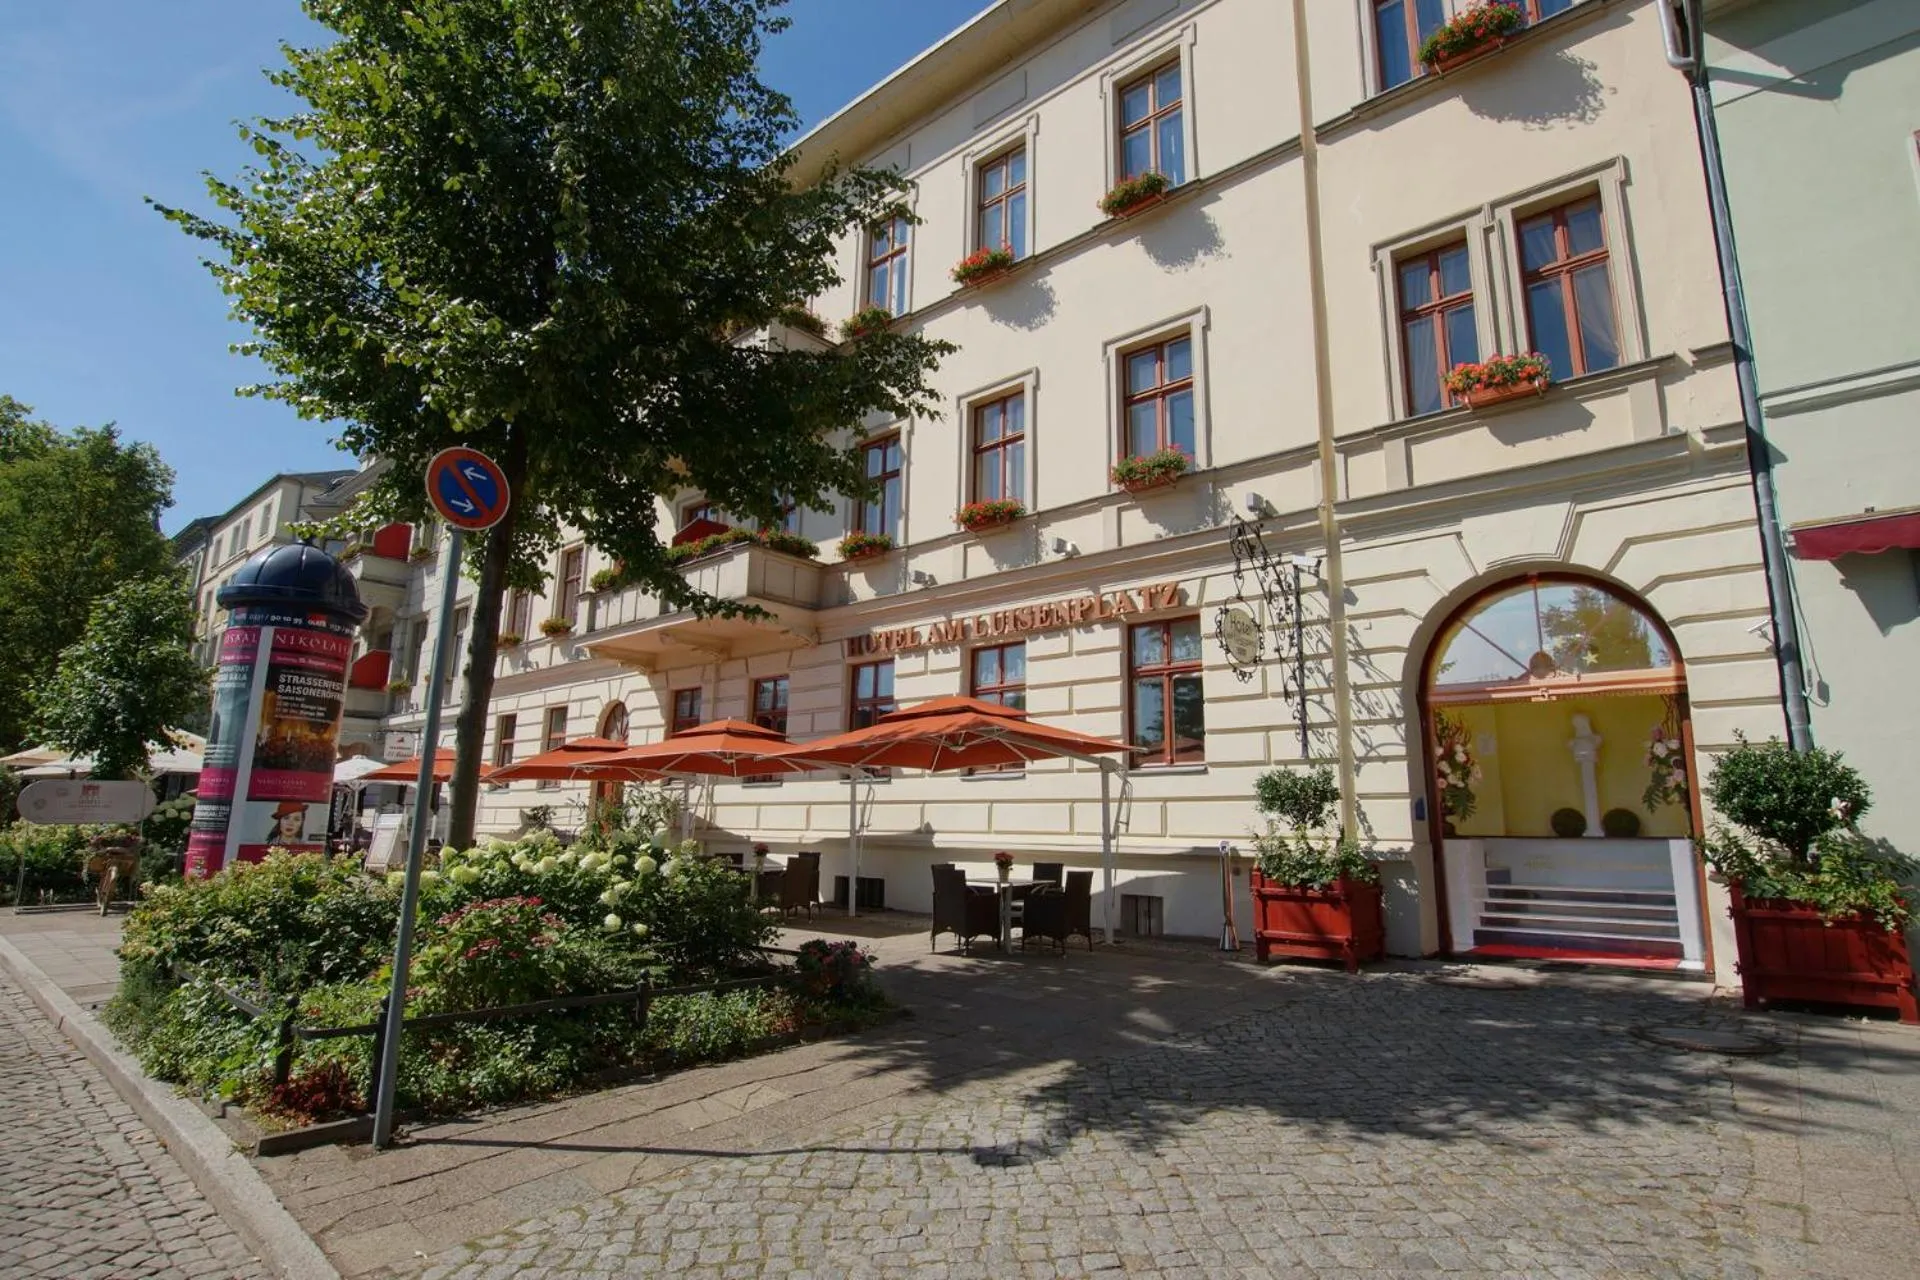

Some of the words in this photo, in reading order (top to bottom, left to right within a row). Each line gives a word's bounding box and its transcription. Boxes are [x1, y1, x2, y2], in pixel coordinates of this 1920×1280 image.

[845, 627, 921, 657] HOTEL
[925, 618, 965, 645] AM
[971, 581, 1180, 640] LUISENPLATZ
